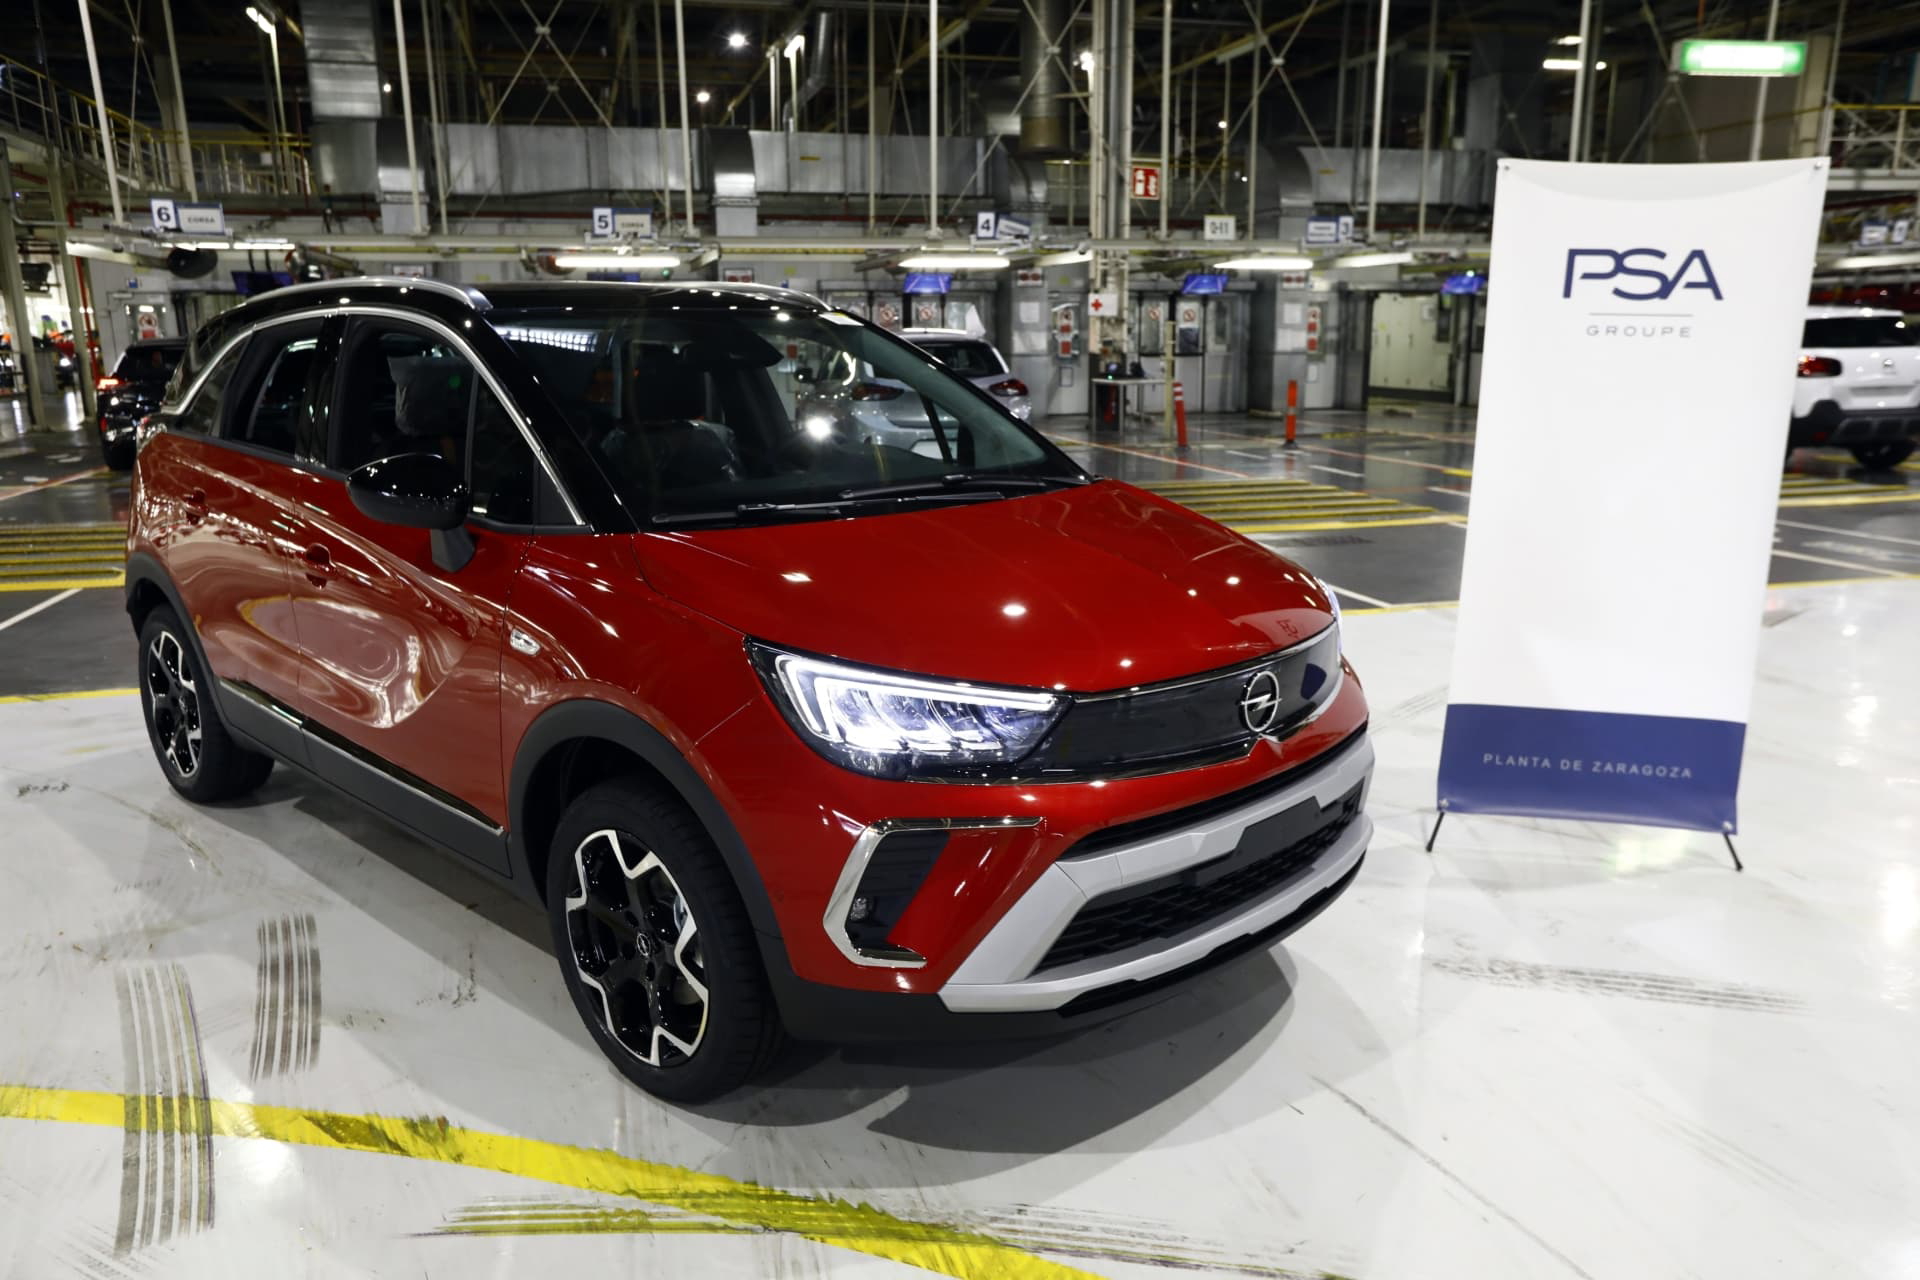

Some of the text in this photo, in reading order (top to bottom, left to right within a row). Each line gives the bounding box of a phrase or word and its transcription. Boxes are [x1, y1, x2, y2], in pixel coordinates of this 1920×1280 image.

[157, 206, 171, 222] 6
[598, 215, 609, 229] 5
[981, 218, 991, 231] 4
[1563, 248, 1724, 300] PSA
[1586, 325, 1692, 338] GROUPE
[1483, 753, 1693, 779] PLANTA DE ZARAGOZA
